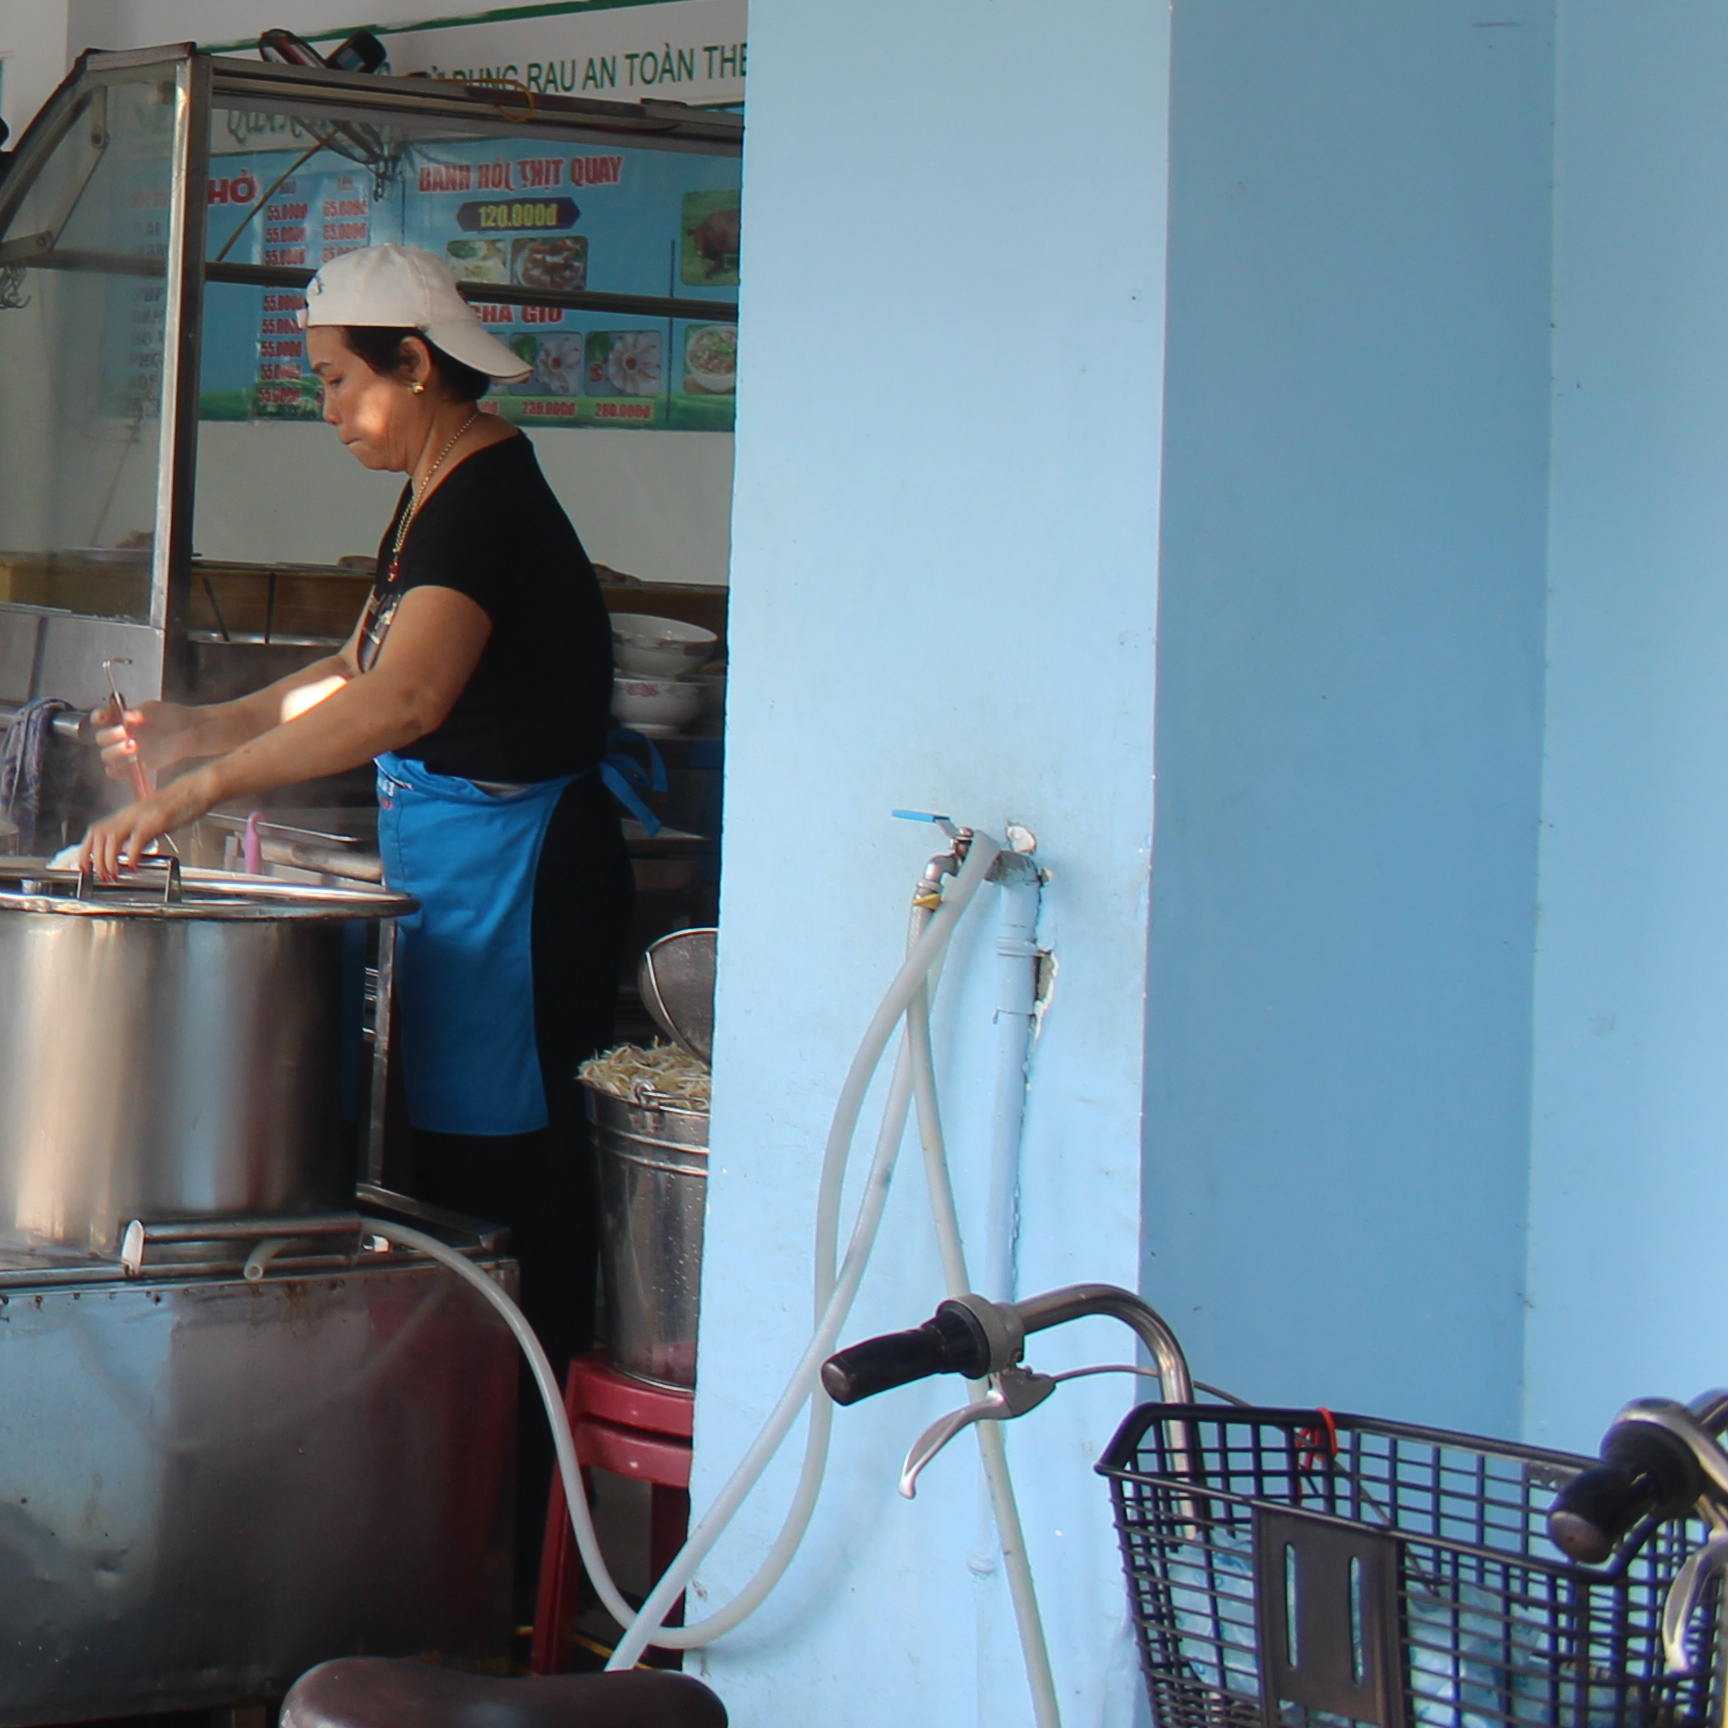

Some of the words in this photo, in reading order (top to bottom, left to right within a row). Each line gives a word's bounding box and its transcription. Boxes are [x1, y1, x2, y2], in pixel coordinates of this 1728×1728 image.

[527, 60, 576, 93] RAU
[581, 55, 616, 90] AN
[624, 41, 695, 86] TOÀN
[207, 168, 257, 205] HỞ
[571, 155, 624, 188] QUAY
